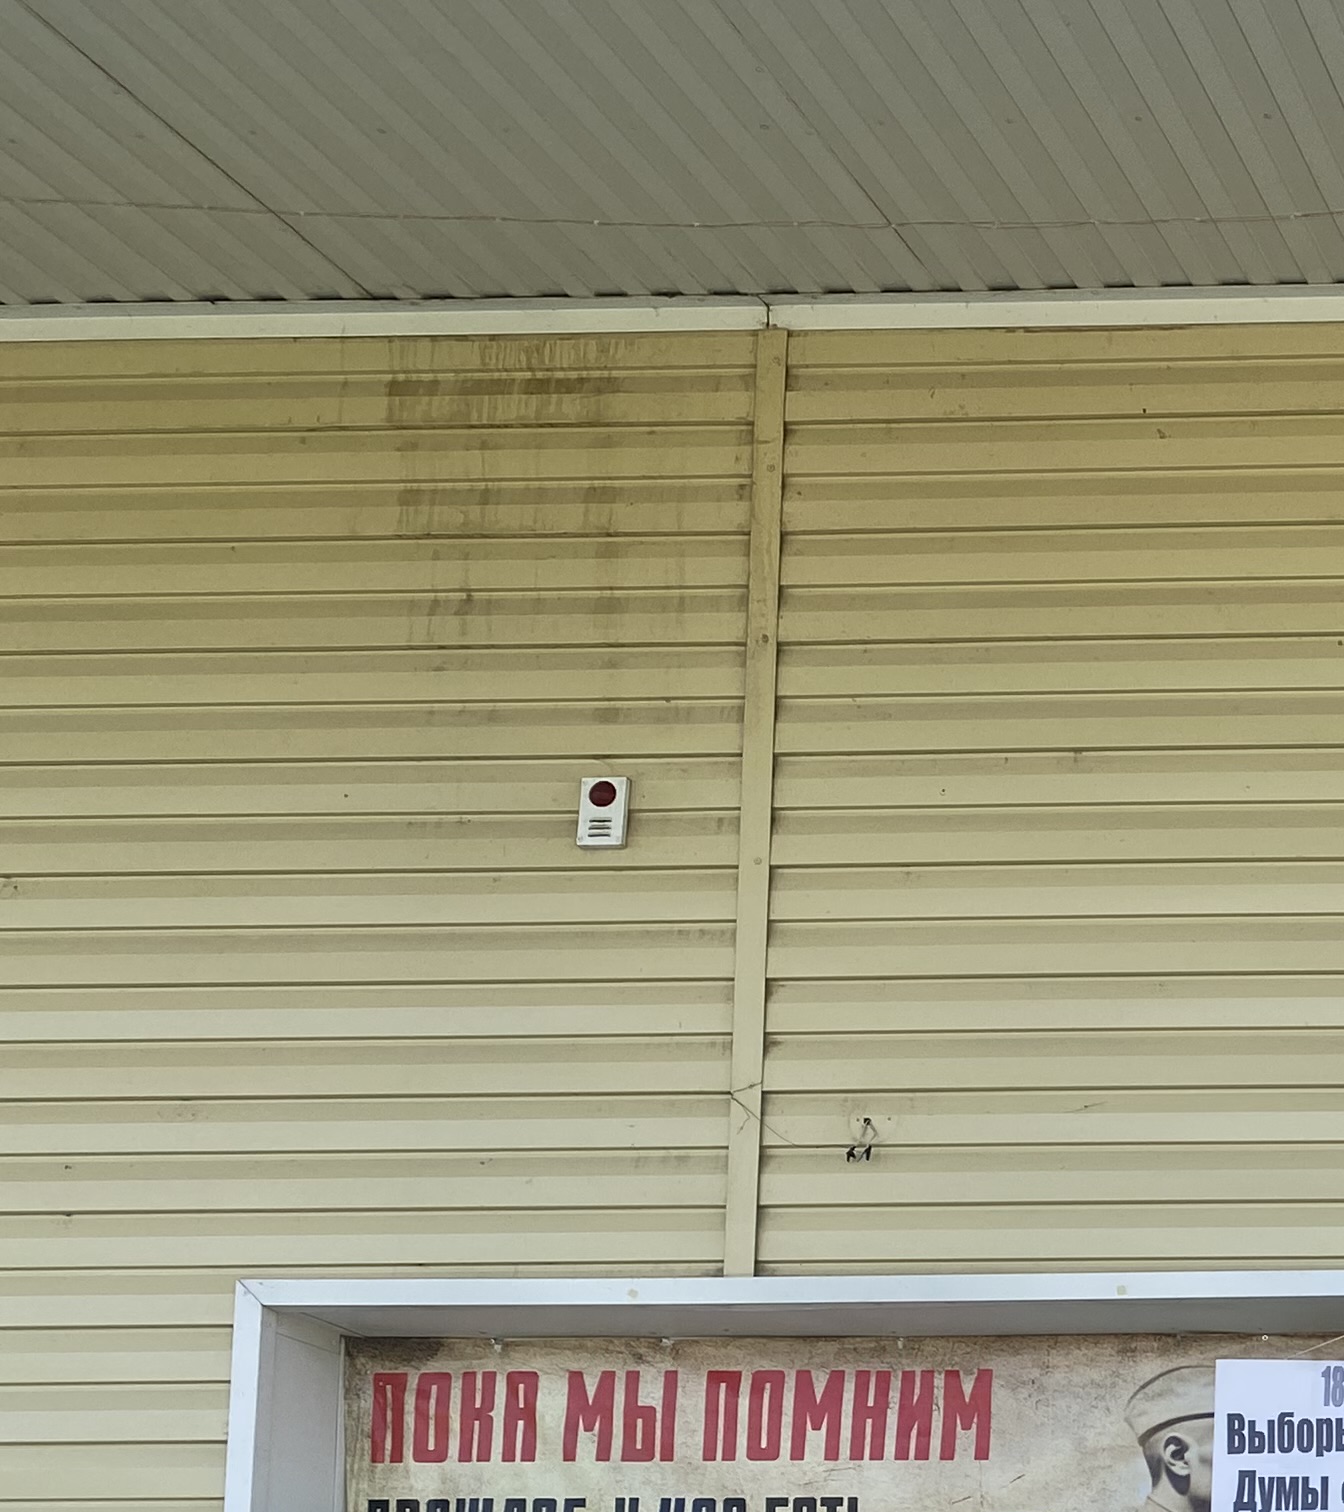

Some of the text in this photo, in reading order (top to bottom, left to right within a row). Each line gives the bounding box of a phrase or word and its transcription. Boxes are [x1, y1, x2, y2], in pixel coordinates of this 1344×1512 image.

[370, 1368, 994, 1464] ПОКА МЫ ПОМНИМ
